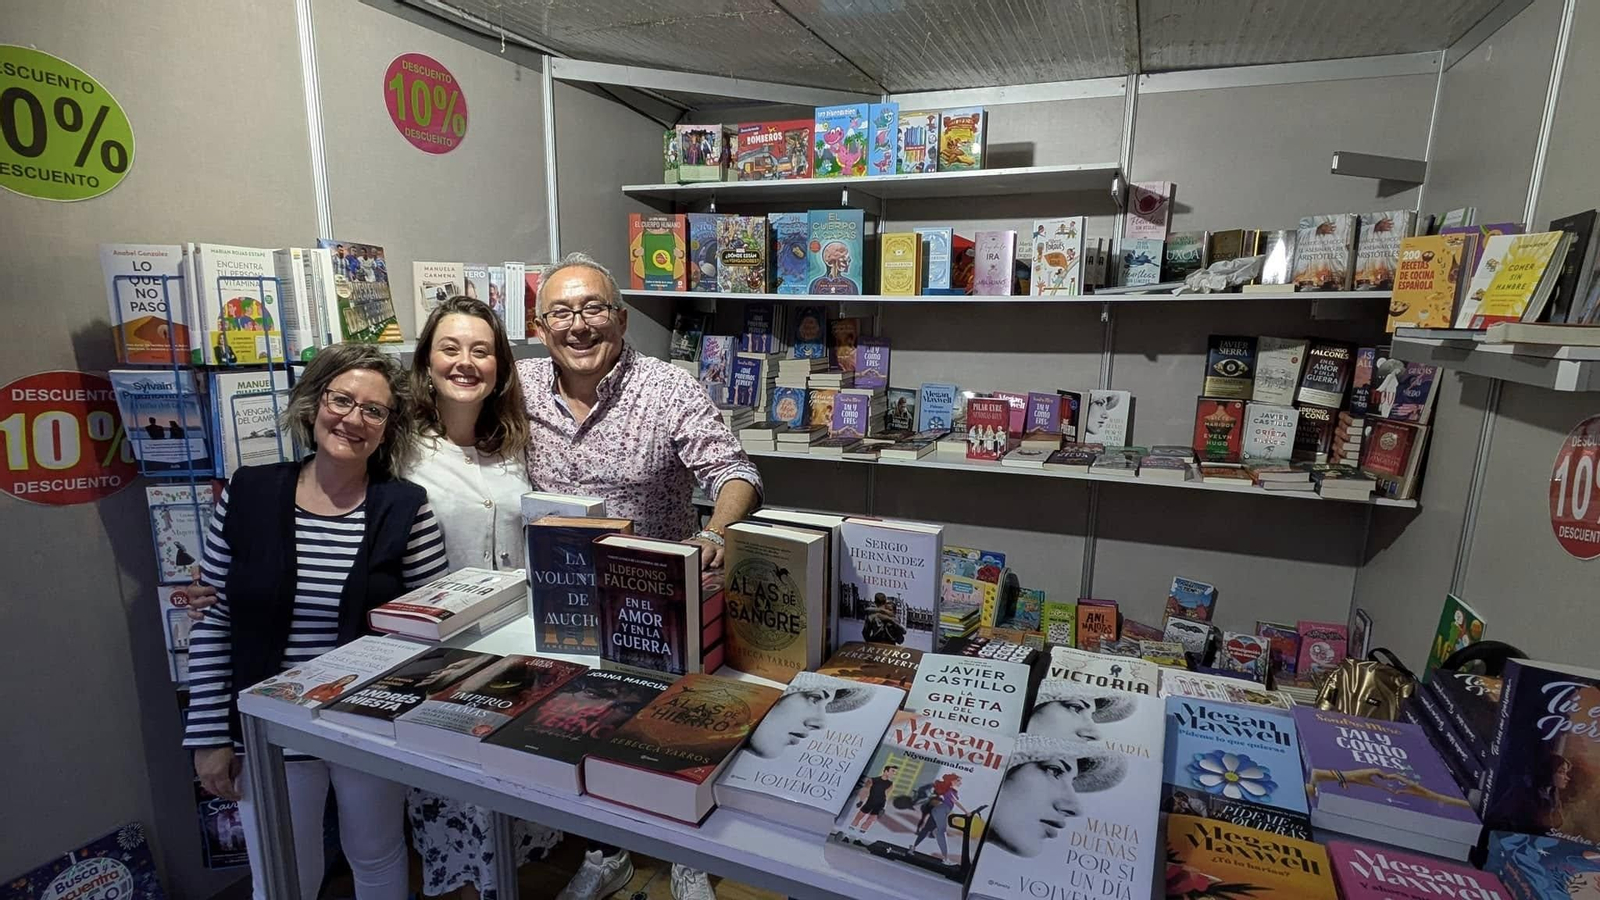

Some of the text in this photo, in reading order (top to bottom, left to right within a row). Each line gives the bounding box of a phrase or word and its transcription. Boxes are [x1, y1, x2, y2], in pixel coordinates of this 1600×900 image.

[0, 62, 95, 94] SCUENTO
[402, 60, 452, 83] DESCUENTO
[389, 72, 466, 137] 10%
[0, 86, 128, 174] 0%
[404, 127, 453, 147] DESCUENTO
[746, 131, 783, 145] BOMBEROS
[0, 161, 100, 188] ESCUENTO
[828, 212, 840, 221] EL
[812, 221, 857, 231] CUERPO
[812, 231, 857, 240] A CAPAS
[986, 253, 1000, 261] IRA
[1298, 252, 1344, 261] ARISTÓTELES
[1402, 250, 1421, 260] 200
[132, 261, 152, 272] LO
[217, 260, 264, 271] ENCUENTRA
[1401, 261, 1430, 270] RECETAS
[1507, 262, 1536, 272] COMER
[129, 276, 162, 287] QUE
[224, 279, 261, 287] VITAMINA
[1399, 270, 1435, 280] DE COCINA
[1509, 272, 1522, 280] SIN
[1398, 279, 1433, 290] ESPAÑOLA
[1495, 282, 1527, 291] HAMBRE
[135, 288, 158, 299] NO
[130, 299, 168, 312] PASÓ
[1218, 347, 1248, 357] SIERRA
[1220, 340, 1248, 349] JAVIER
[864, 352, 881, 360] COMO
[1310, 349, 1349, 360] FALCONES
[1313, 363, 1339, 373] AMOR
[133, 382, 173, 394] Sylvain
[1306, 374, 1339, 385] GUERRA
[925, 390, 949, 398] Megan
[841, 410, 859, 418] COMO
[973, 403, 1002, 412] PILAR EYRE
[1033, 410, 1051, 418] COMO
[1259, 412, 1289, 420] JAVIER
[238, 416, 251, 425] DEL
[1253, 418, 1293, 428] CASTILLO
[0, 410, 135, 471] 10%
[1255, 429, 1287, 438] GRIETA
[1571, 434, 1600, 448] DESCU
[13, 475, 121, 495] DESCUENTO
[1556, 455, 1600, 525] 10
[865, 537, 909, 553] SERGIO
[565, 552, 587, 566] LA
[850, 547, 925, 568] HERNÁNDEZ
[535, 570, 596, 586] VOLUNT
[609, 563, 667, 581] ILDEFONSO
[857, 561, 916, 580] LA LETRA
[426, 580, 495, 596] VICTORIA
[604, 573, 674, 596] FALCONES
[730, 576, 796, 606] ALAS DE
[863, 575, 909, 591] HERIDA
[568, 593, 589, 606] DE
[625, 598, 653, 611] EN EL
[618, 608, 663, 628] AMOR
[728, 600, 801, 635] SANGRE
[621, 623, 660, 639] Y EN LA
[612, 632, 672, 656] GUERRA
[857, 645, 912, 660] ARTURO
[767, 654, 801, 670] YARROS
[587, 671, 622, 682] JOANA
[623, 676, 670, 691] MARCÚS
[940, 664, 1006, 681] JAVIER
[1051, 667, 1149, 694] VICTORIA
[925, 674, 1017, 694] CASTILLO
[344, 695, 403, 712] INIESTA
[353, 688, 421, 705] ANDRÉS
[450, 691, 513, 709] IMPERIO
[928, 692, 1003, 713] GRIETA
[1541, 681, 1592, 715] Tú
[668, 698, 741, 720] ALAS DE
[953, 705, 973, 714] DEL
[1182, 702, 1276, 731] Megan
[651, 708, 730, 732] HIERRO
[922, 708, 1001, 728] SILENCIO
[1315, 713, 1364, 728] Sandra
[909, 717, 994, 752] Megan
[1173, 711, 1291, 747] Maxwell
[1335, 725, 1392, 746] TAL Y
[825, 729, 864, 748] MARÍA
[610, 737, 710, 765] REBECCA YARROS
[806, 739, 858, 760] DUEÑAS
[895, 729, 1003, 770] Maxwell
[1105, 741, 1150, 758] MARÍA
[1336, 736, 1408, 760] COMO
[798, 753, 851, 773] POR SI
[1351, 749, 1404, 770] ERES
[795, 766, 842, 788] UN DÍA
[752, 771, 836, 801] VOLVEMOS
[1222, 805, 1291, 828] PÍDEME
[1086, 817, 1139, 844] MARÍA
[1546, 827, 1593, 846] Sandra
[1070, 831, 1138, 861] DUEÑAS
[1194, 822, 1303, 858] Megan
[1185, 833, 1321, 876] Maxwell
[1066, 849, 1135, 882] POR SI
[1354, 849, 1480, 891] Megan
[55, 865, 99, 895] Busca
[1070, 870, 1132, 900] UN DÍA
[1349, 860, 1503, 900] Maxwell
